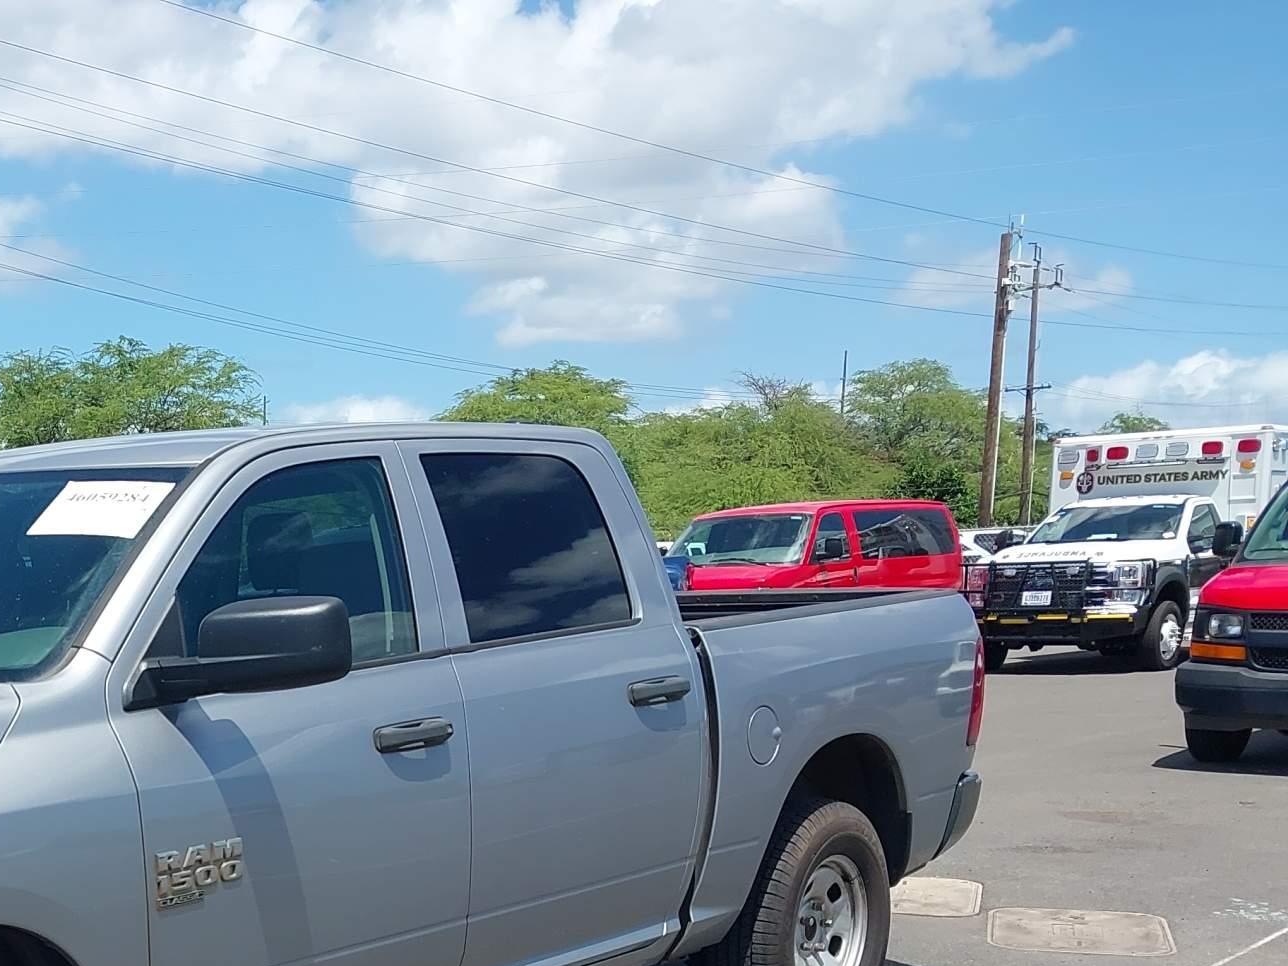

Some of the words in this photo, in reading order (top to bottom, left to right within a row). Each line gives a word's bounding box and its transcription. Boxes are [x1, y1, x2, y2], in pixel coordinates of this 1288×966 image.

[1097, 473, 1141, 485] UNITED
[1143, 471, 1189, 483] STATES
[1192, 469, 1229, 481] ARMY
[155, 836, 242, 873] RAM
[156, 860, 242, 896] 1500
